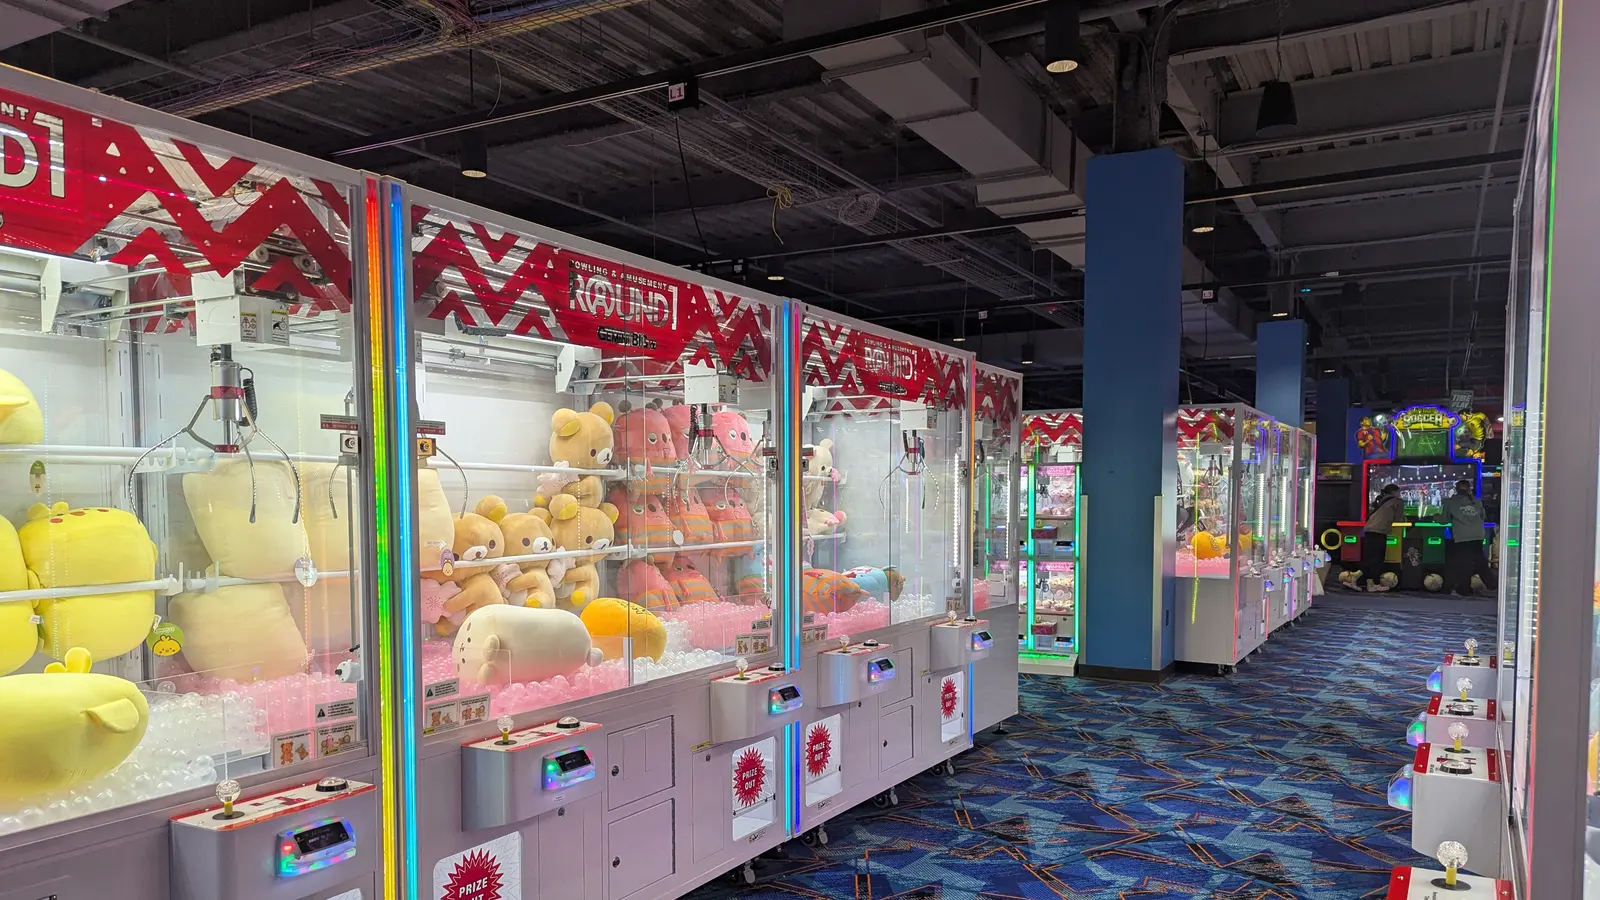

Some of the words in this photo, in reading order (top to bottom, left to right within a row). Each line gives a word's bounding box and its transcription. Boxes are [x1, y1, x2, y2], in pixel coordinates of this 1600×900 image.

[670, 86, 683, 99] L1
[569, 260, 608, 276] BOWLING
[611, 270, 617, 278] &
[620, 273, 667, 290] AMUSEMENT
[1403, 413, 1443, 428] SOCCER
[742, 767, 757, 781] PRIZE
[744, 779, 756, 790] OUT
[458, 877, 488, 899] PRIZE
